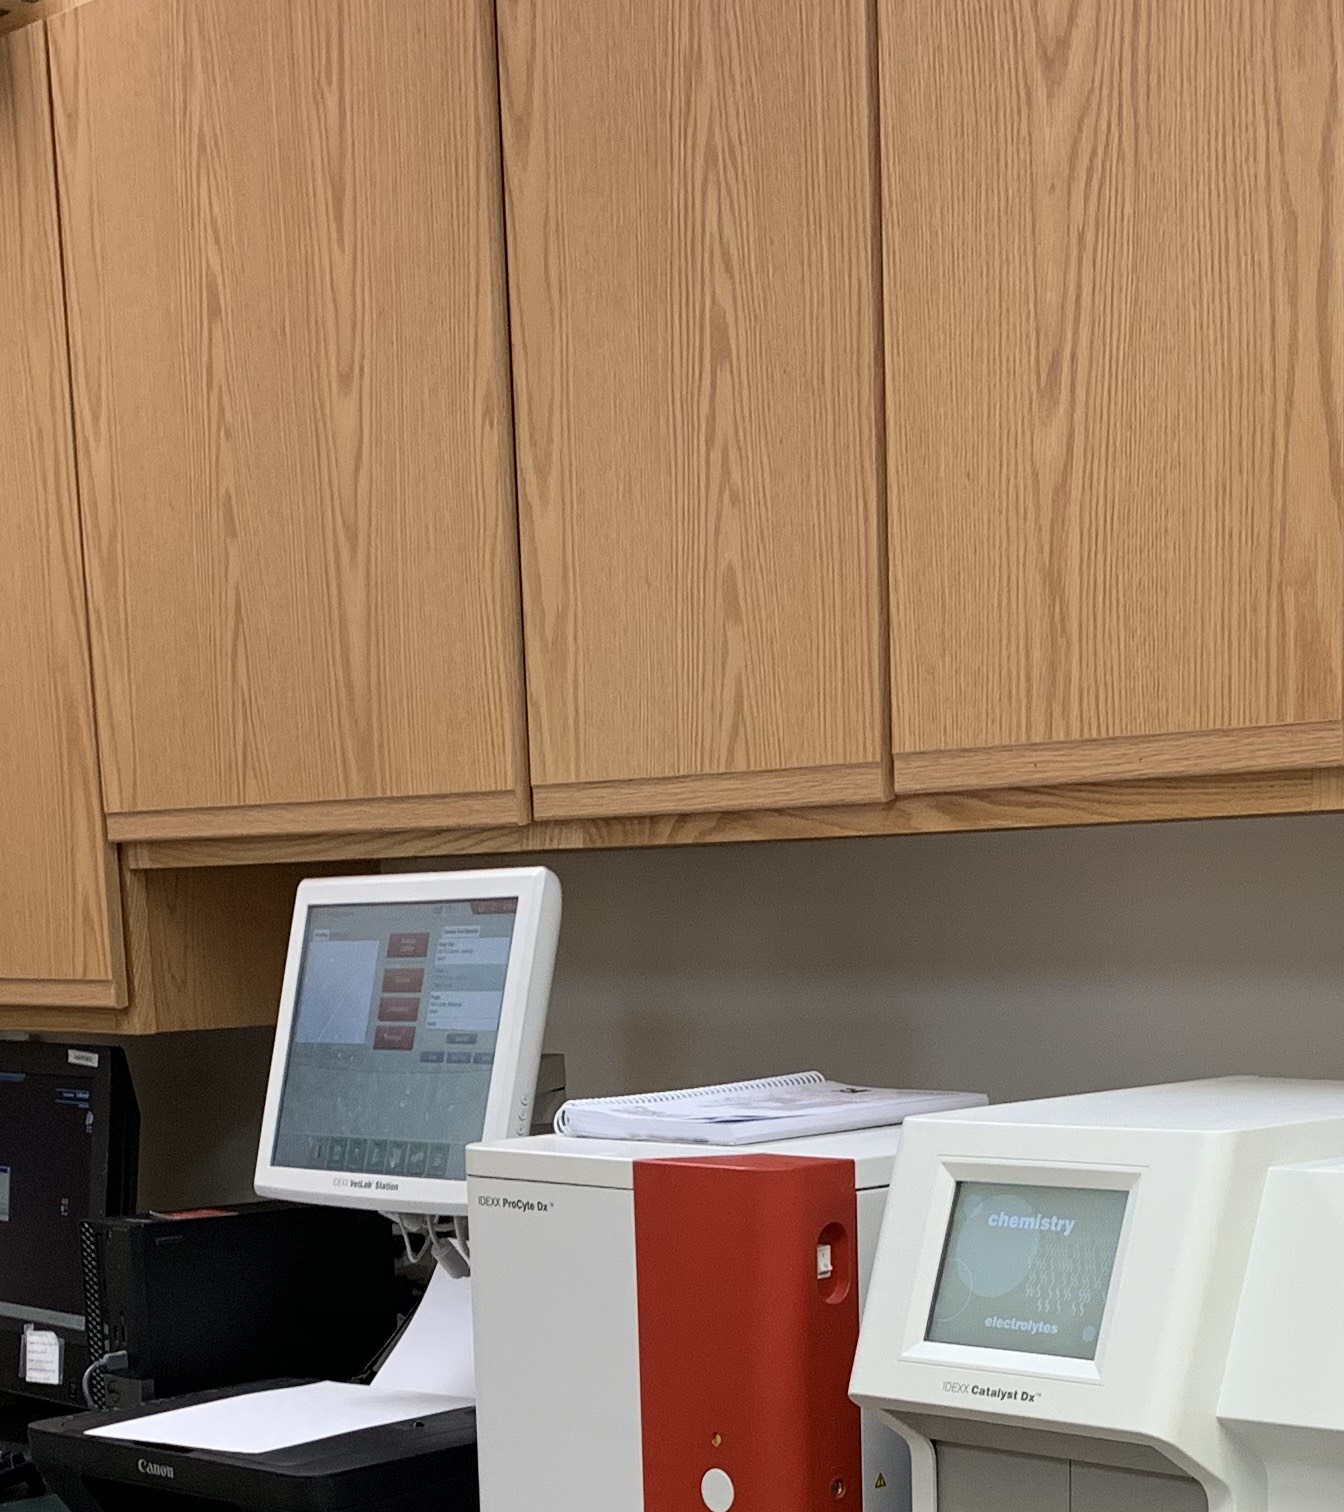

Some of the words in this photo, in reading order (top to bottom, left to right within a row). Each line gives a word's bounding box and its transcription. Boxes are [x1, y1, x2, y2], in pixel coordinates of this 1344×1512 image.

[375, 1180, 399, 1191] Station
[478, 1195, 501, 1207] IDEXX
[502, 1199, 535, 1212] ProCyte
[988, 1212, 1075, 1236] chemistry
[984, 1315, 1059, 1335] electrolytes
[942, 1381, 970, 1394] IDEXX
[971, 1384, 1018, 1401] Catalyst
[137, 1459, 174, 1479] Canon
